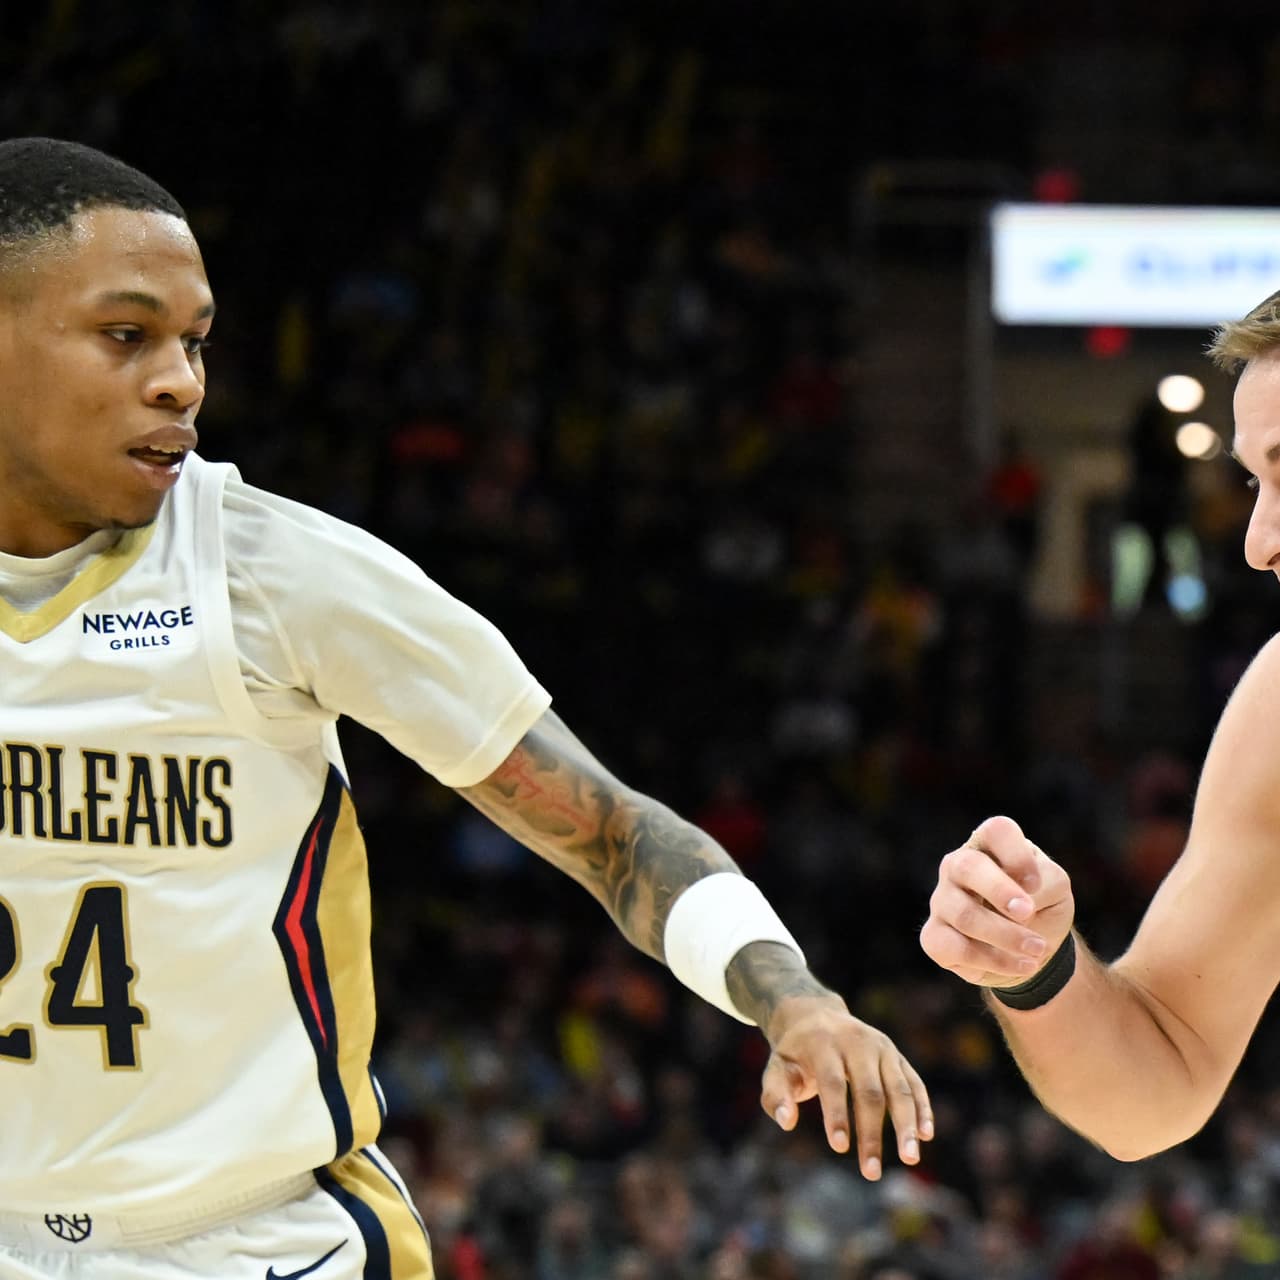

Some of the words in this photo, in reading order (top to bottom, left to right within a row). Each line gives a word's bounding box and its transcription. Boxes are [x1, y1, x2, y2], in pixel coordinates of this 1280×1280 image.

[83, 606, 193, 634] NEWAGE
[110, 635, 170, 650] GRILLS
[0, 740, 234, 850] RLEANS
